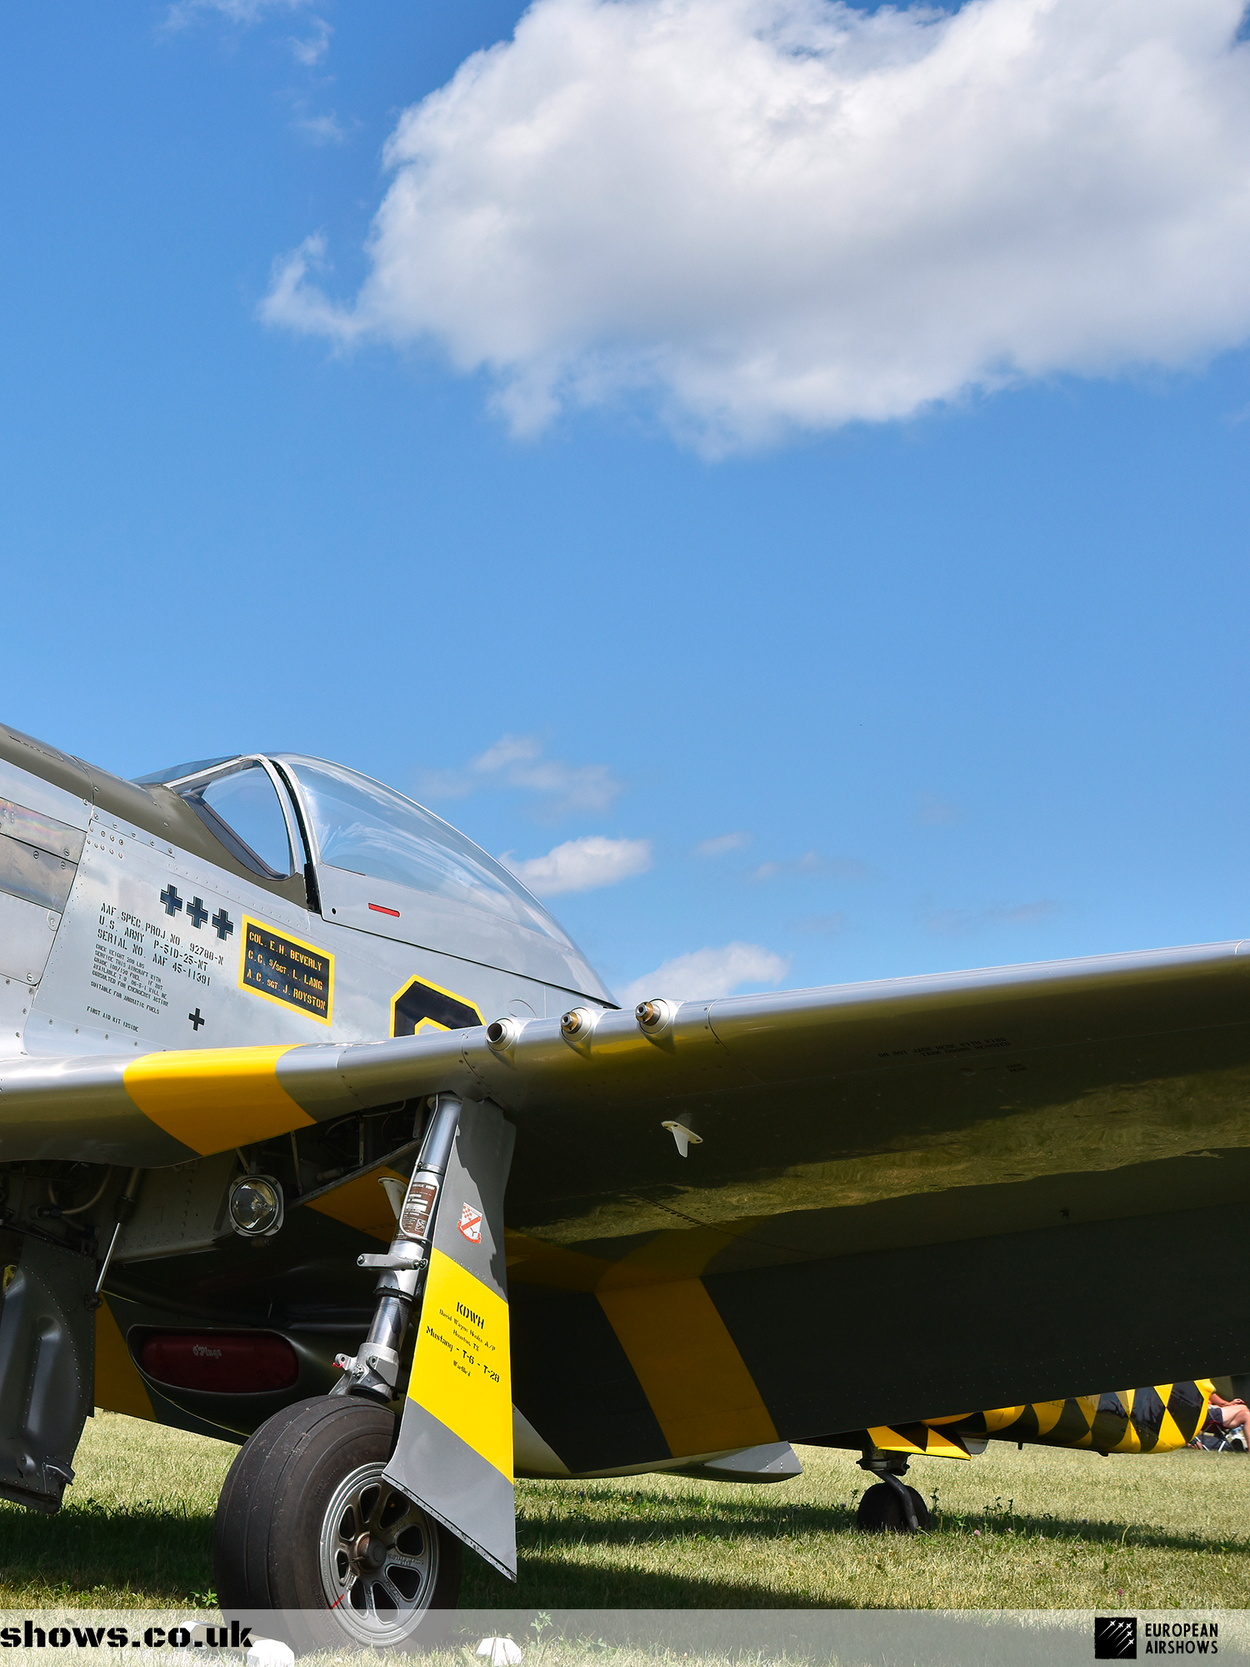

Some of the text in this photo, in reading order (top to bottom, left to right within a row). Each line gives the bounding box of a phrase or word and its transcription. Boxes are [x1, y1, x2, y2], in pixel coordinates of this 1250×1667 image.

[99, 915, 118, 932] U.S.
[124, 927, 145, 943] ARMY
[97, 928, 210, 987] SERIAL NO. AAF 45-11391
[248, 949, 266, 966] C.C.
[292, 969, 301, 981] L.
[304, 974, 323, 991] LANG
[249, 932, 322, 972] COL. E.H. BEVERLY
[247, 969, 265, 984] A.C.
[283, 984, 291, 996] J.
[293, 988, 326, 1010] ROYSTON
[457, 1302, 484, 1329] KDWH
[426, 1326, 454, 1352] Mustang
[462, 1350, 475, 1365] T-6
[484, 1365, 500, 1383] T-28
